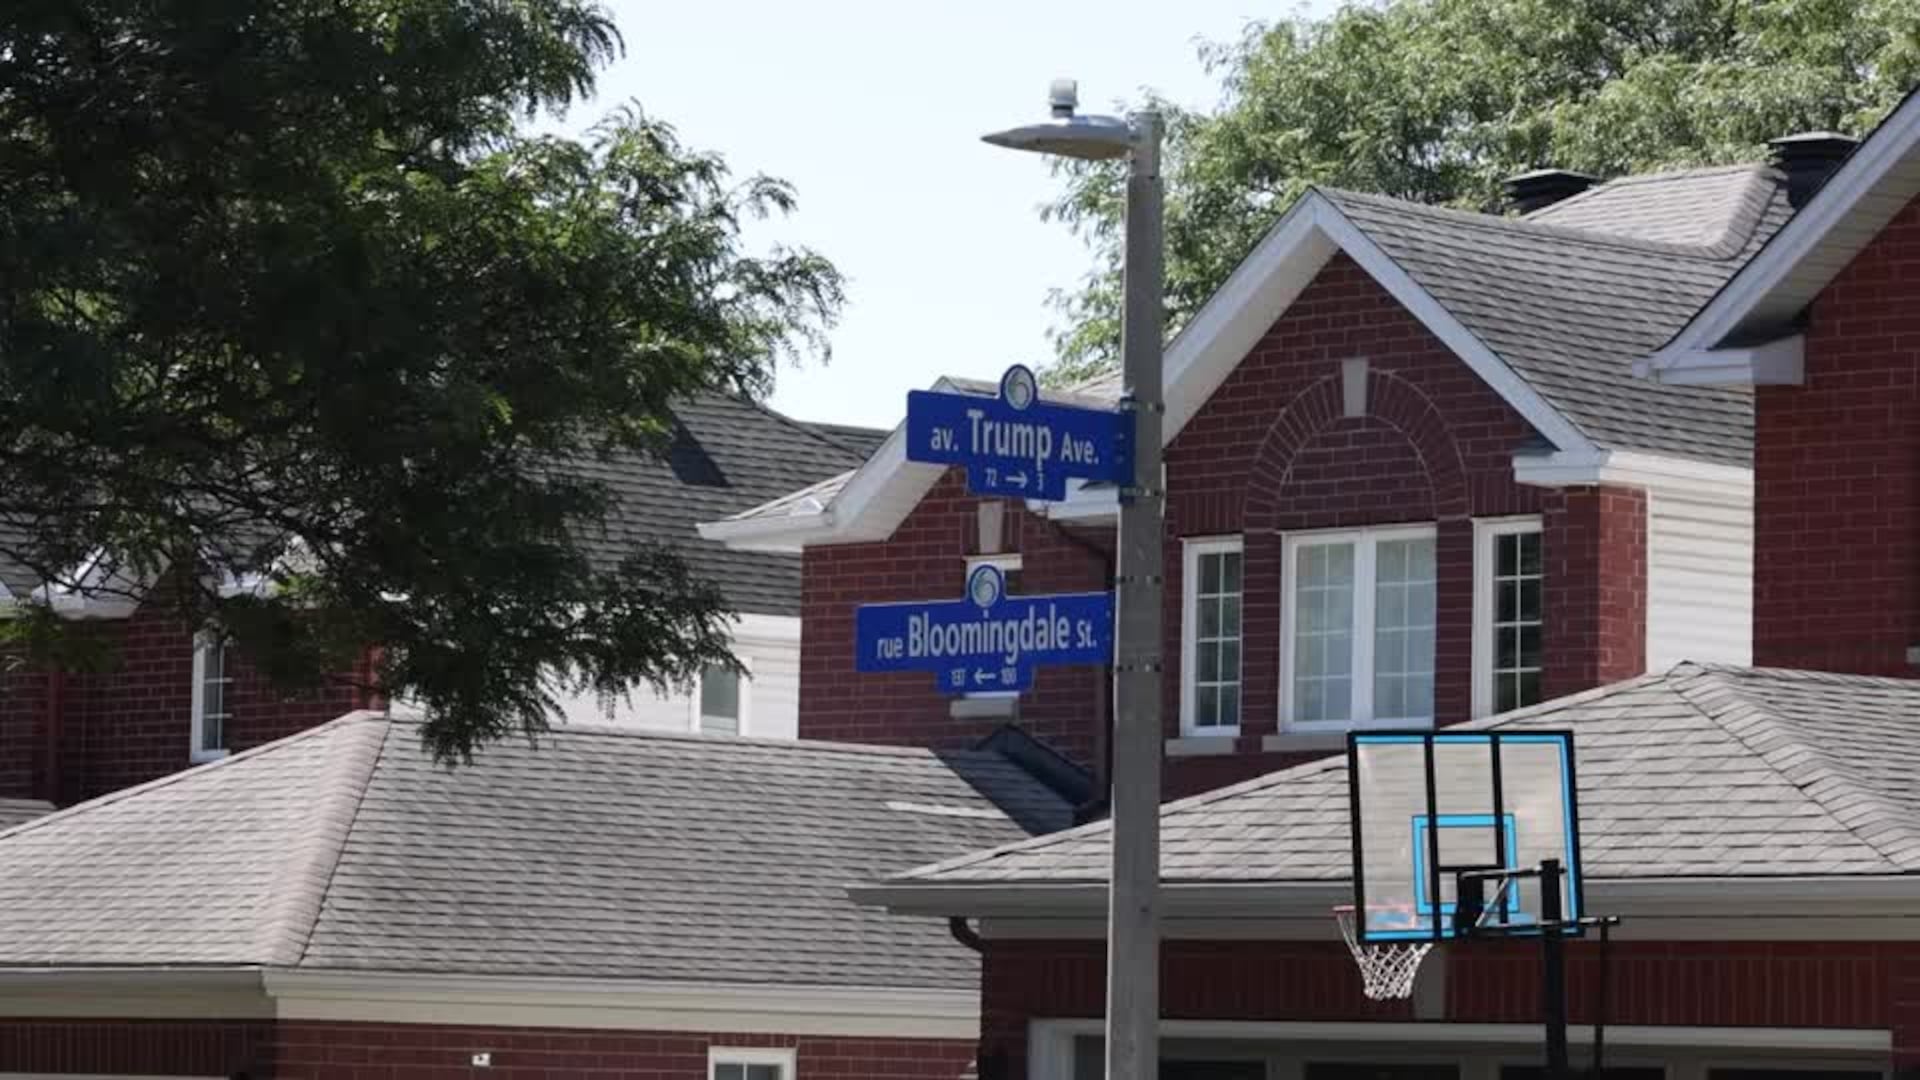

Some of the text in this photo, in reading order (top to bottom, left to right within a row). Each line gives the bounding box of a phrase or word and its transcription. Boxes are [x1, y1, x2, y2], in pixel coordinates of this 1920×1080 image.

[931, 408, 1099, 471] av. Trump Ave.
[877, 603, 1097, 665] rue Bloomingdale St.
